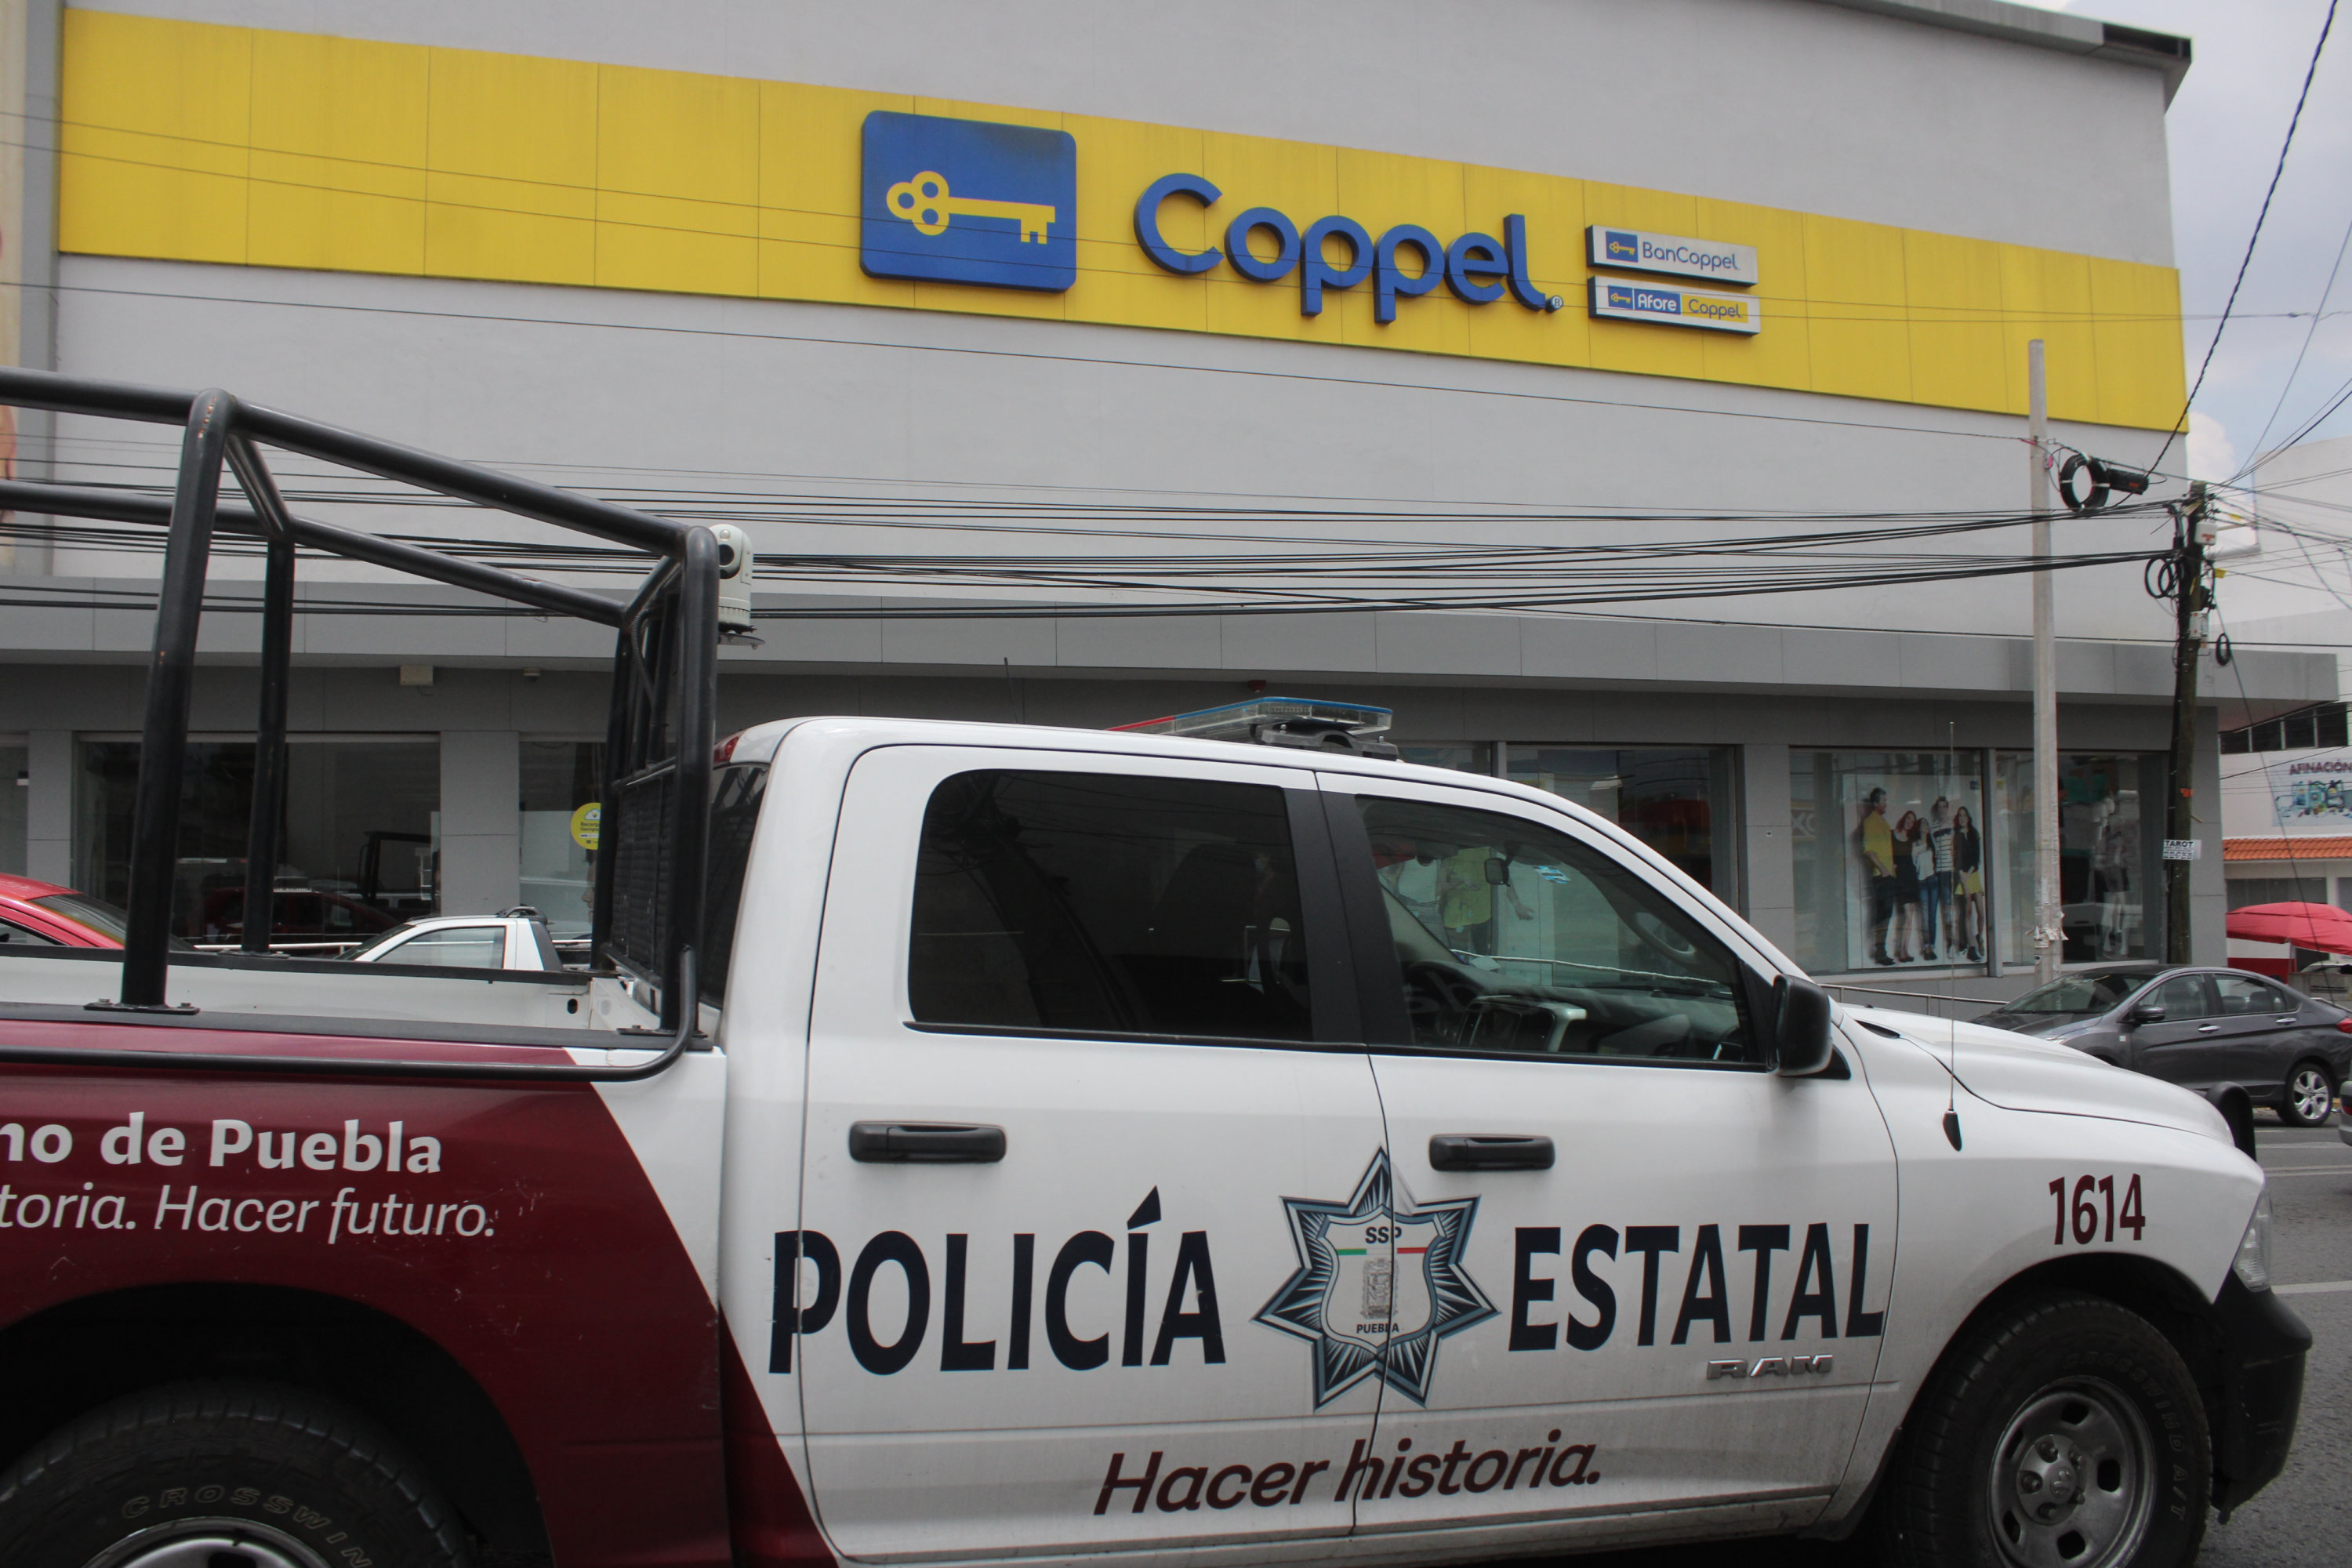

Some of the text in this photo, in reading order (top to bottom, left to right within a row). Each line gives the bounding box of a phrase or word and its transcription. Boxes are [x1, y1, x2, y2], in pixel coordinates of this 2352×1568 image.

[1642, 241, 1739, 271] BanCoppel
[1638, 293, 1742, 320] Afore Coppel
[100, 1111, 186, 1166] de
[209, 1119, 441, 1174] Puebla
[154, 1185, 318, 1233] Hacer
[328, 1187, 495, 1244] futuro.
[2049, 1174, 2146, 1245] 1614
[1365, 1226, 1402, 1244] SSP
[768, 1185, 1885, 1374] POLICÍA ESTATAL
[1356, 1323, 1399, 1334] PUEBLA
[1707, 1354, 1833, 1380] RAM
[1093, 1428, 1601, 1515] Hacer historia.
